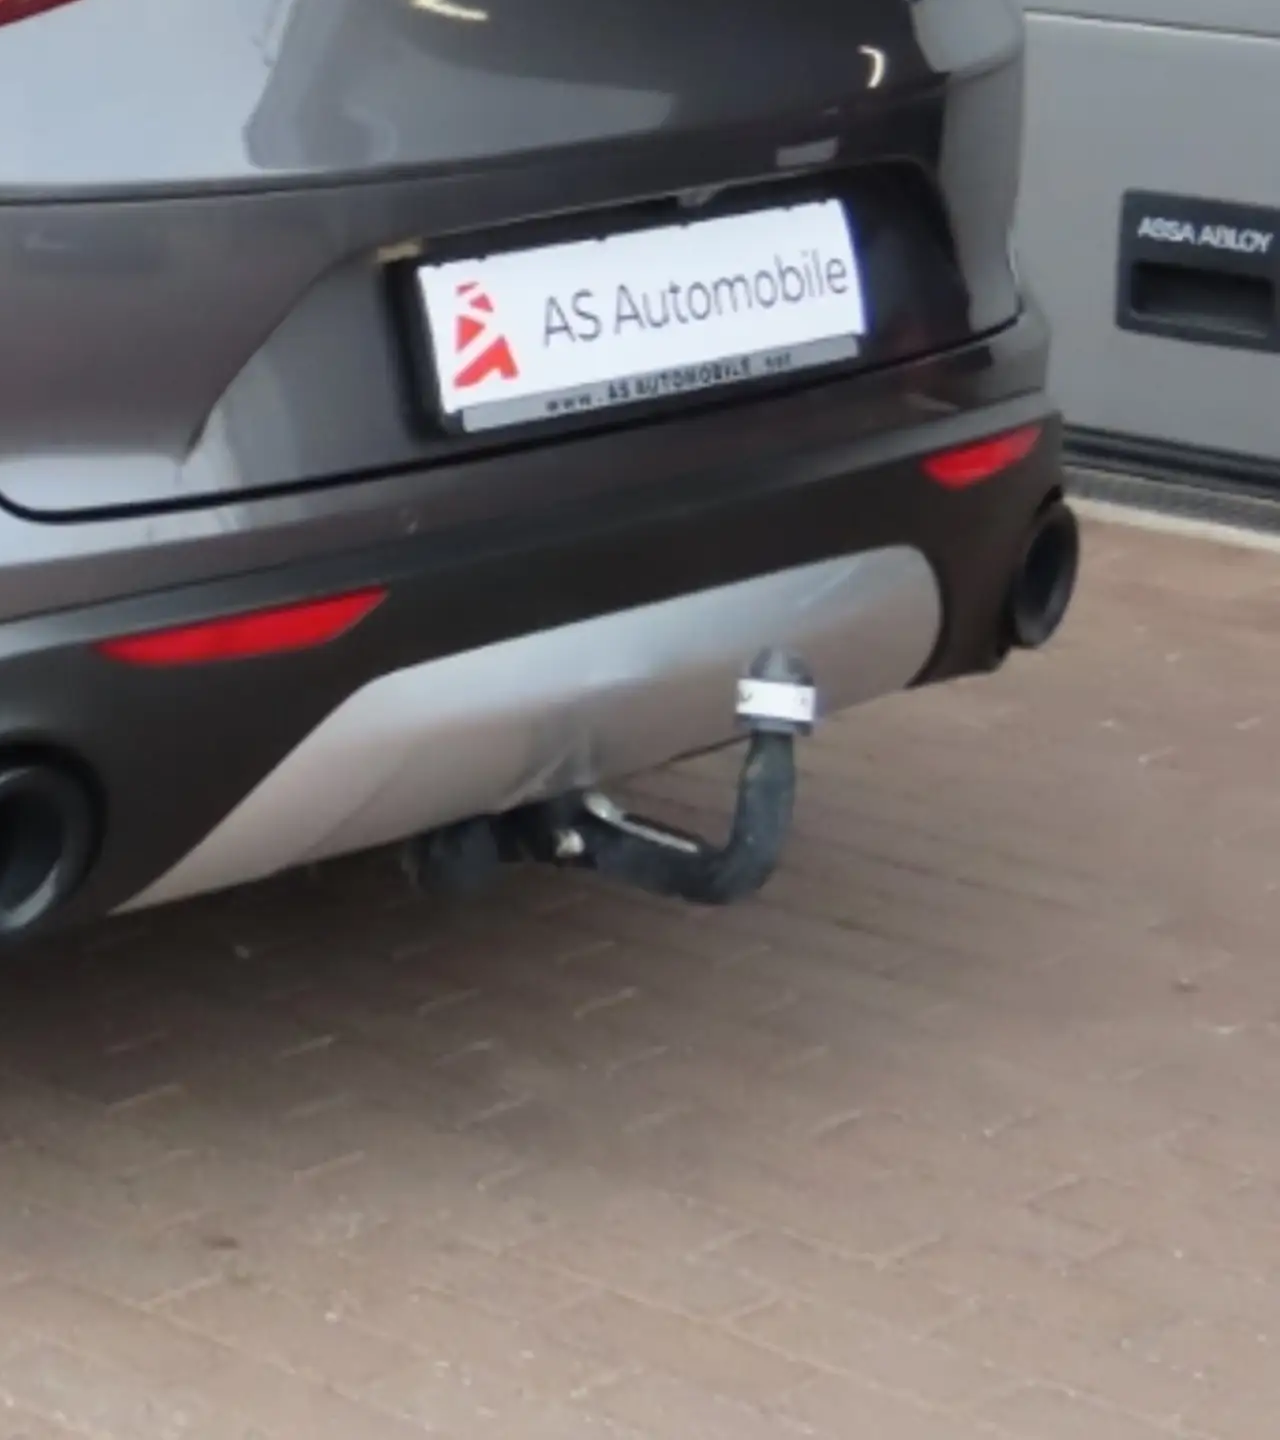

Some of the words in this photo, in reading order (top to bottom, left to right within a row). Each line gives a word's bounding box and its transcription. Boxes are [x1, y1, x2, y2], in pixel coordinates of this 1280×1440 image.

[1197, 224, 1274, 254] ABLOY
[542, 289, 602, 347] AS
[613, 248, 849, 336] Automobile
